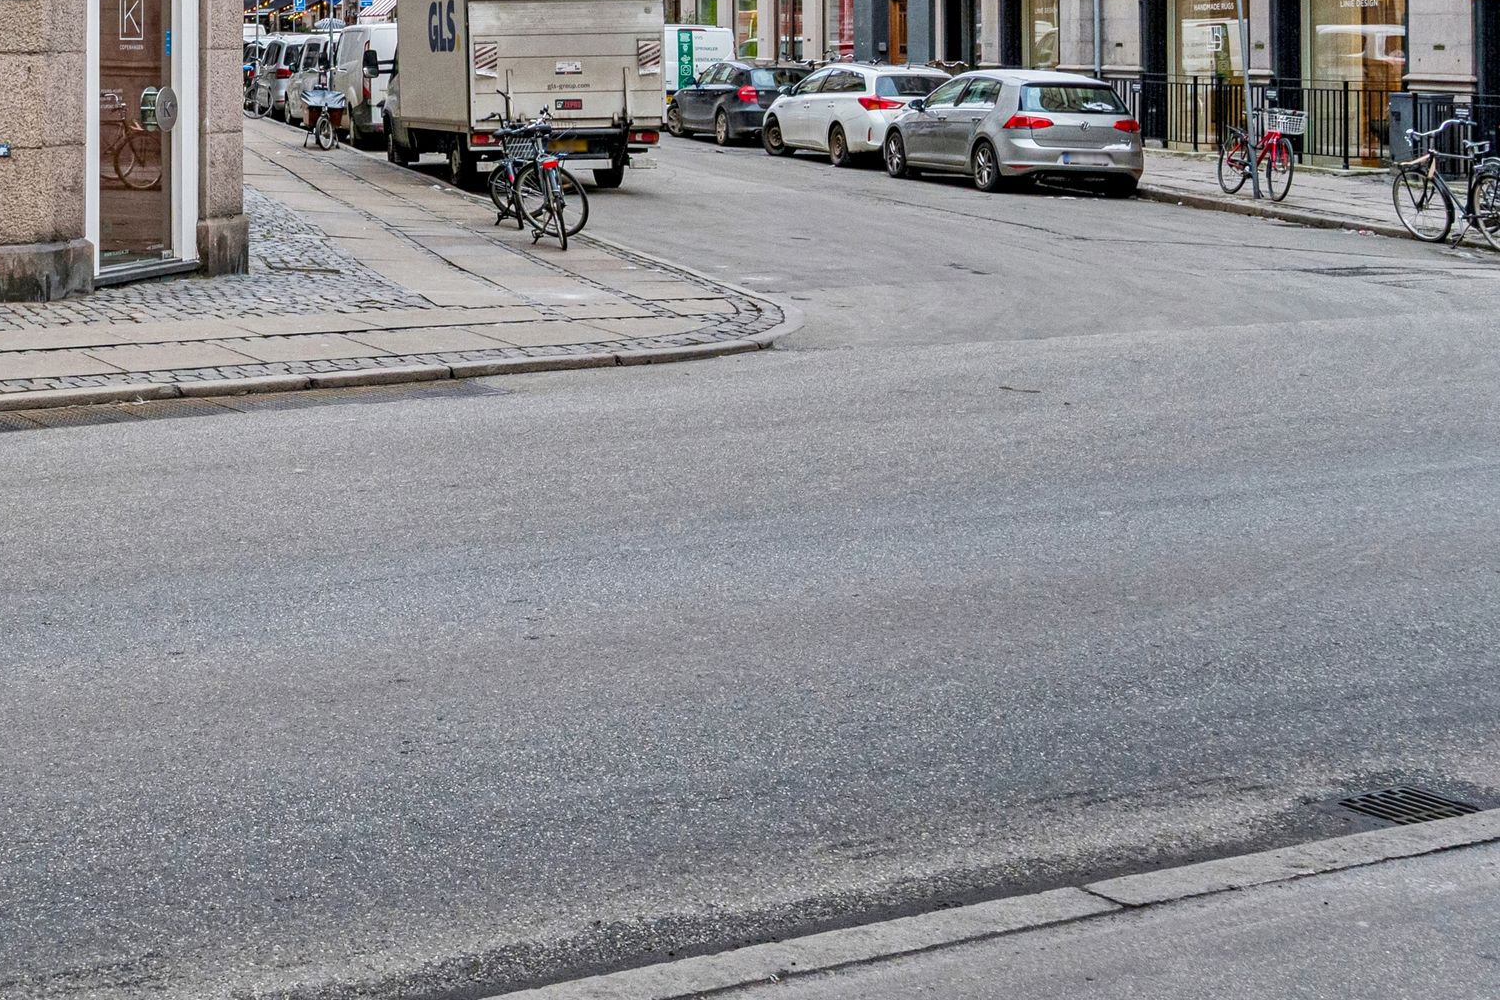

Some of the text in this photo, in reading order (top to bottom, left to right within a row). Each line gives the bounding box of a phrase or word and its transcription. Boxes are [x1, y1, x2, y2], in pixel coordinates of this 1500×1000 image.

[1194, 2, 1234, 11] HANDMADE RUGS
[1356, 0, 1379, 7] DESIGN
[124, 0, 141, 33] K
[547, 83, 590, 91] gls-group.com
